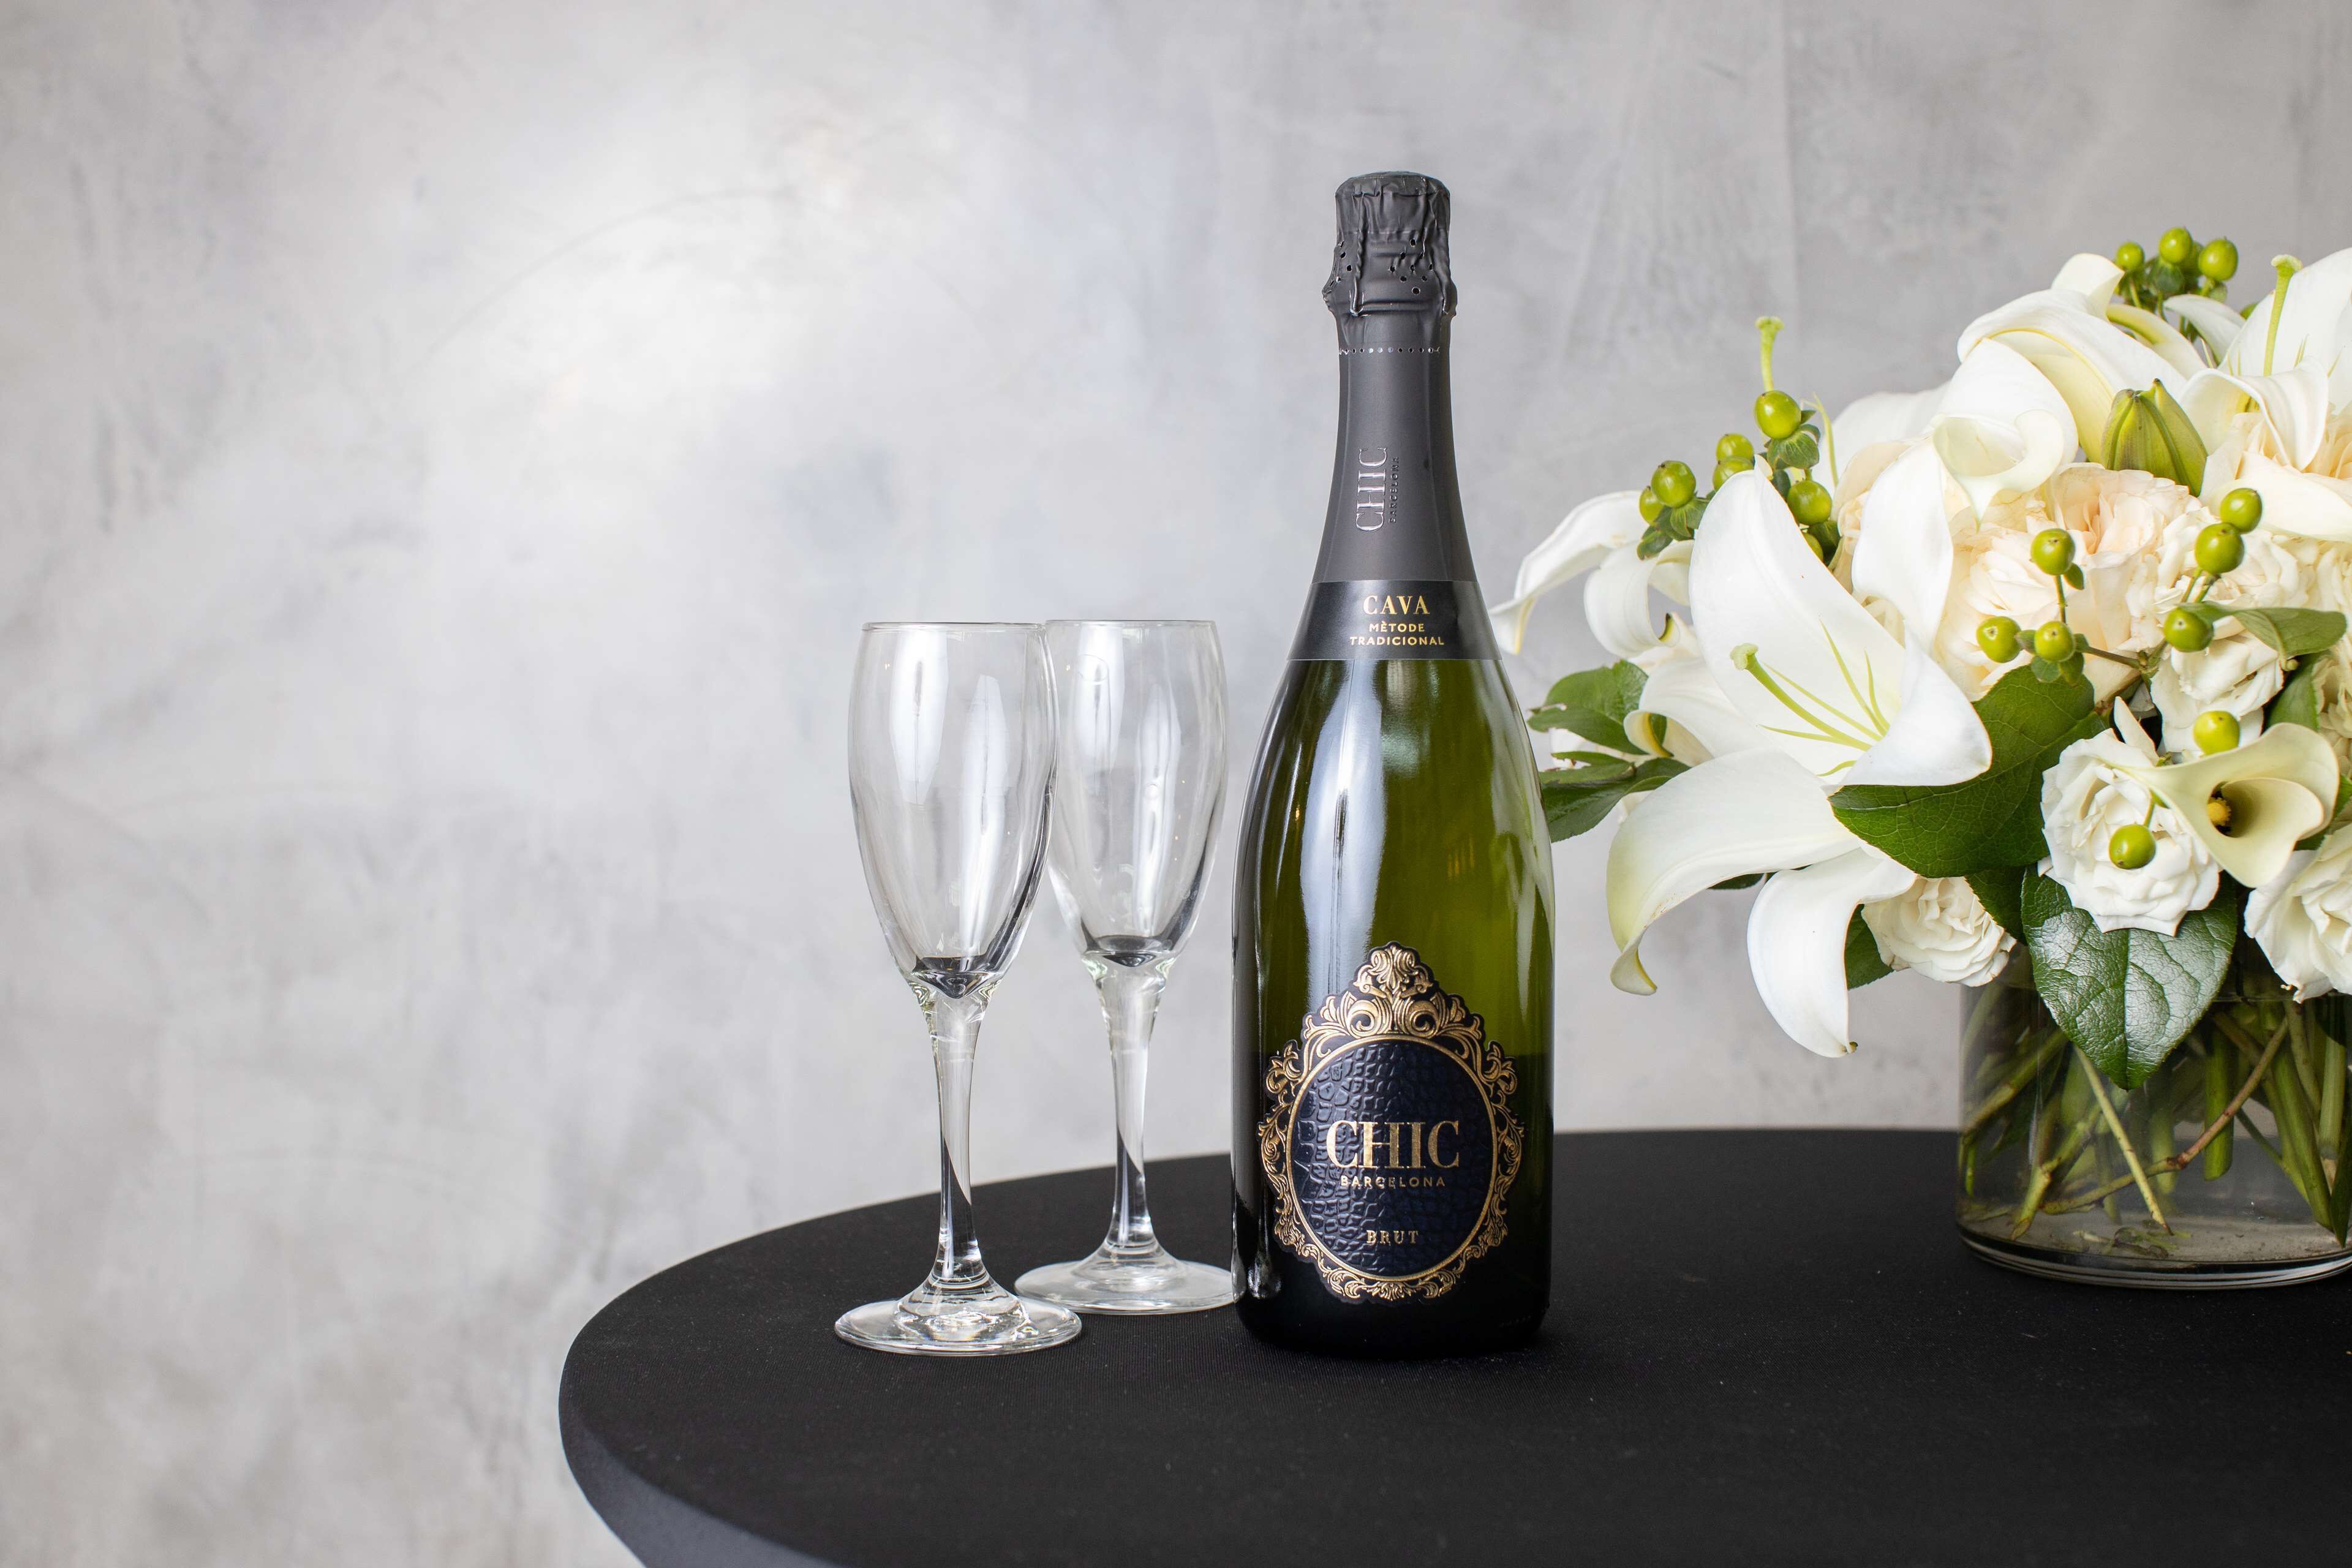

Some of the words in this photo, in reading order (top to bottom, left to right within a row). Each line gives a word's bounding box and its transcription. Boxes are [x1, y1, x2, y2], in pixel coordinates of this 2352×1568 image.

[1355, 447, 1387, 532] CHIC
[1389, 456, 1400, 523] BARCELONA
[1363, 595, 1430, 615] CAVA
[1369, 621, 1425, 633] MÈTODE
[1350, 636, 1444, 646] TRADICIONAL
[1326, 1120, 1460, 1169] CHIC
[1340, 1175, 1446, 1188] BARCELONA
[1366, 1229, 1419, 1245] BRUT
